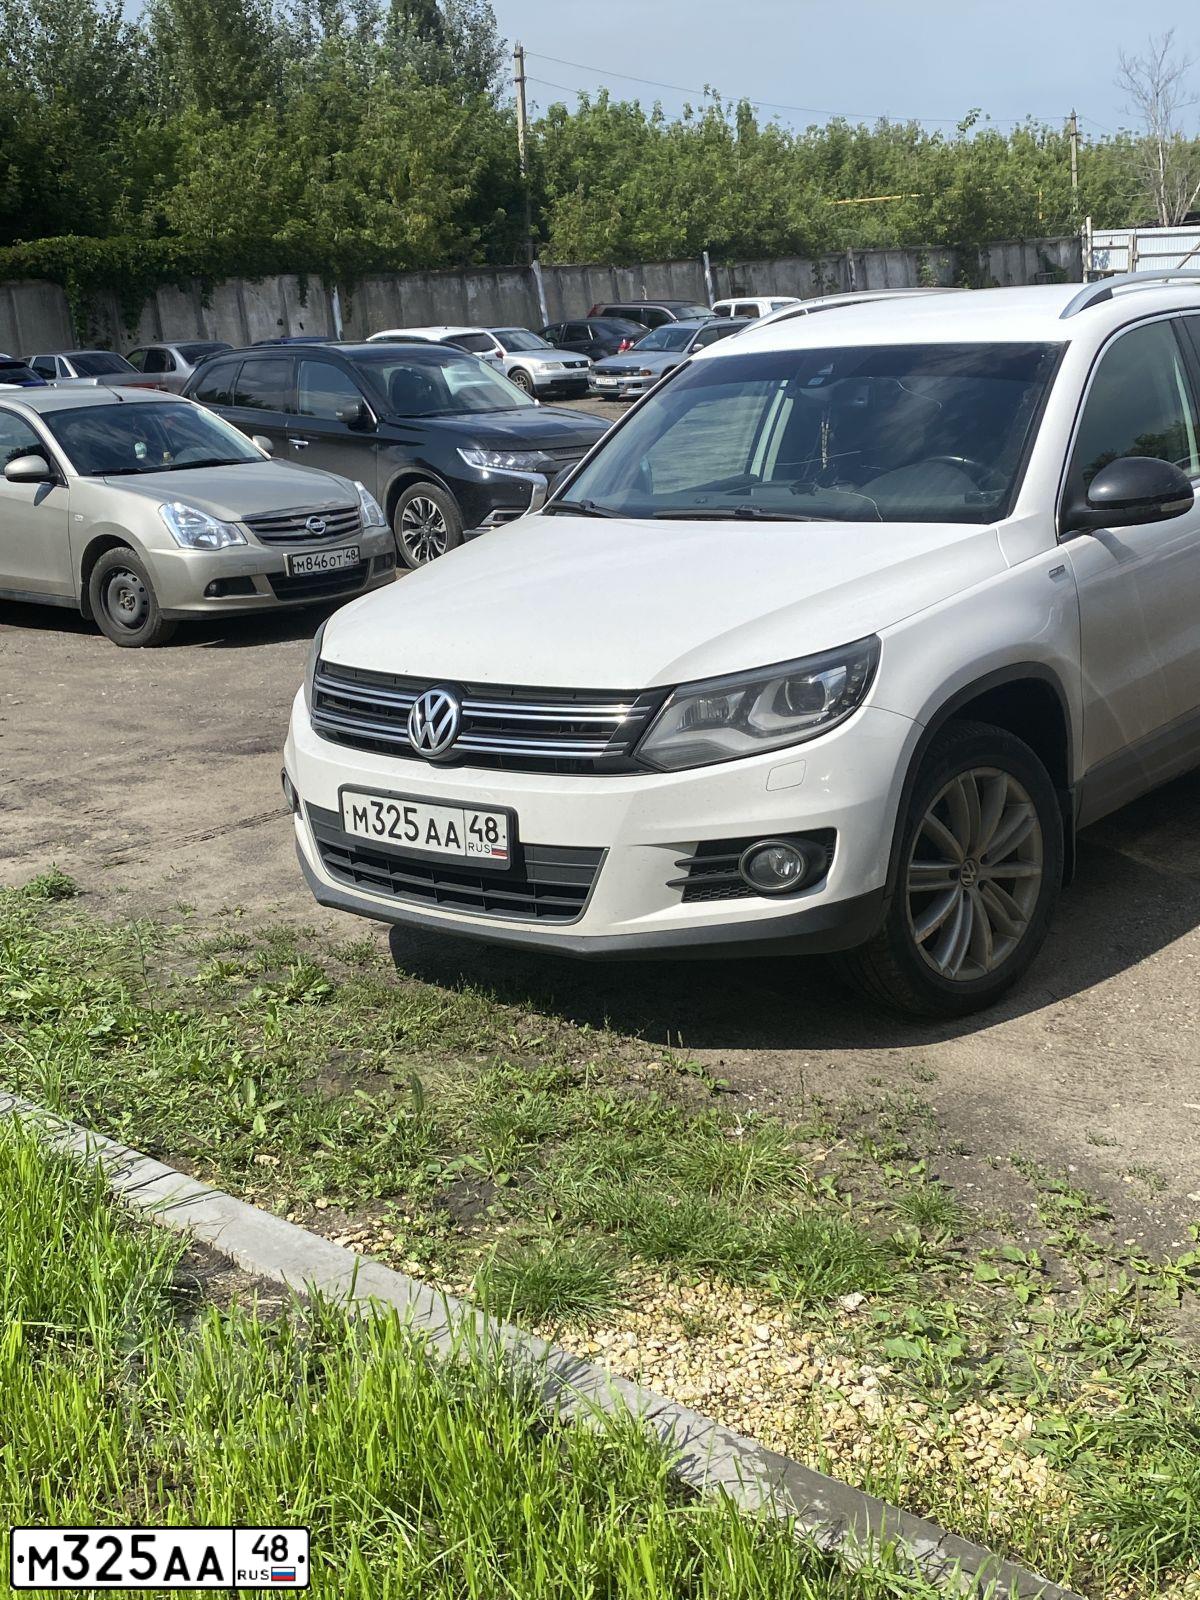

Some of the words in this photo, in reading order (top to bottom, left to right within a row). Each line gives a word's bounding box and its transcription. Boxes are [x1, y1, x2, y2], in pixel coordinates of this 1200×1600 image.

[346, 549, 356, 560] 48
[353, 801, 461, 849] М325АА
[469, 814, 499, 843] 48
[468, 842, 491, 854] RUS
